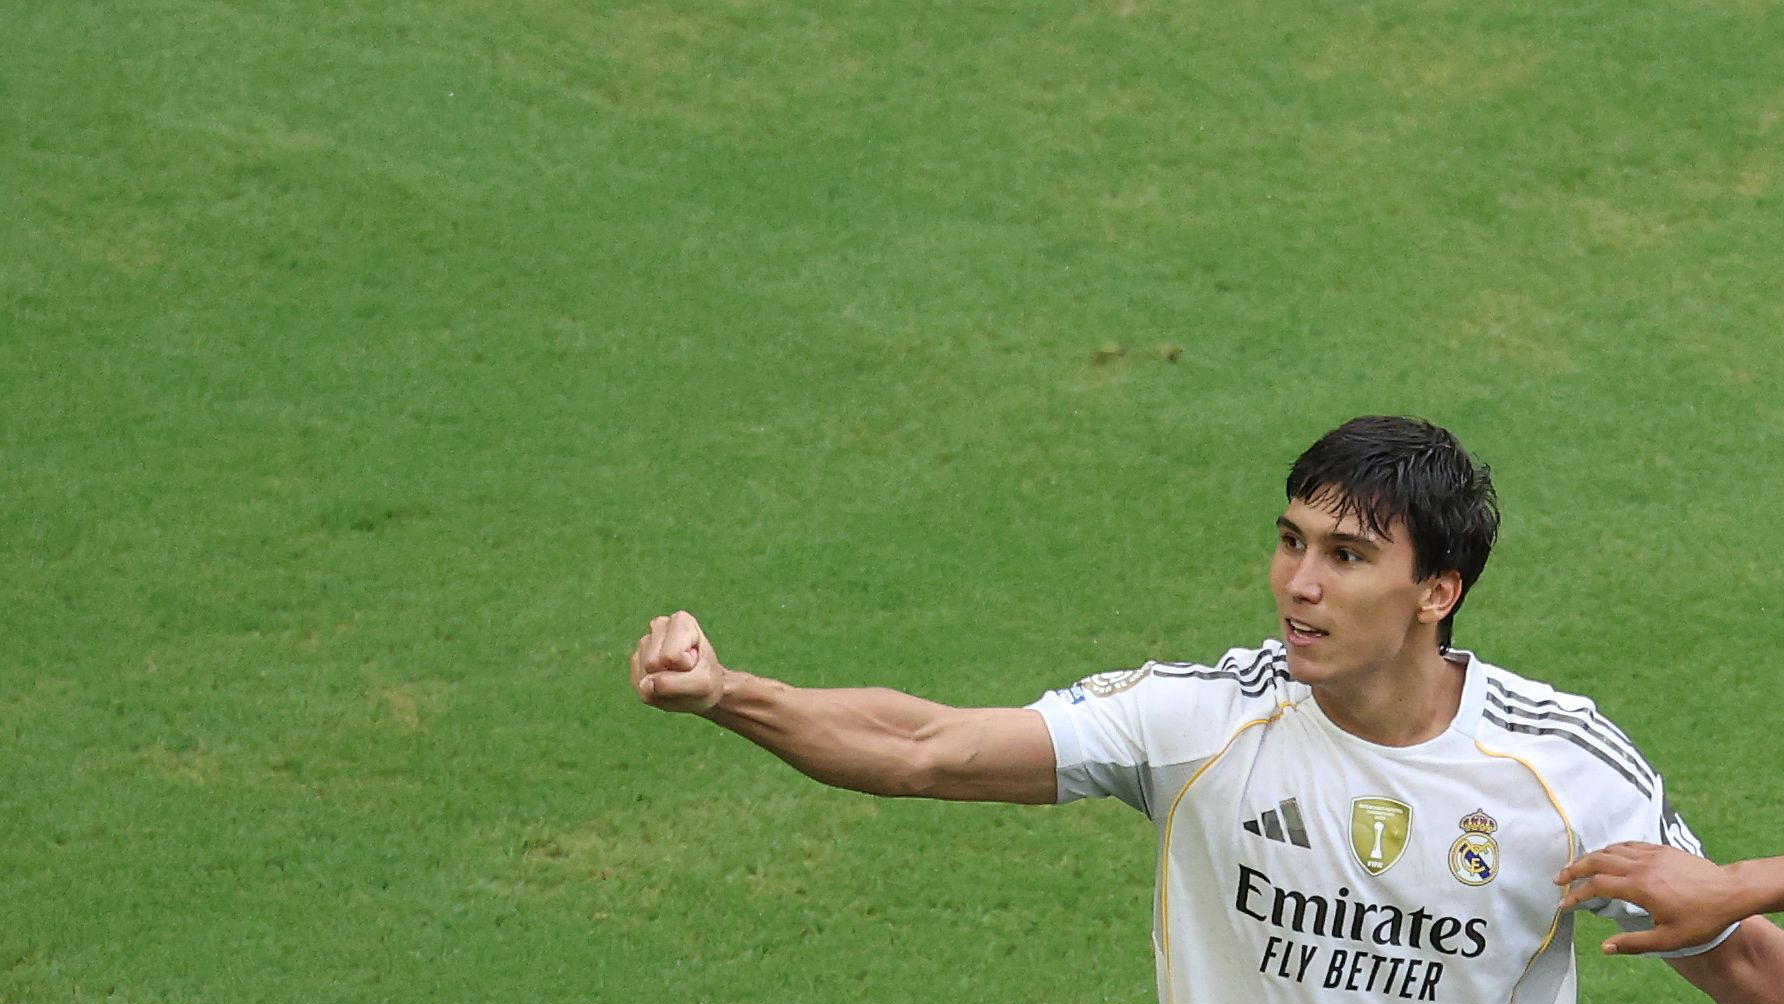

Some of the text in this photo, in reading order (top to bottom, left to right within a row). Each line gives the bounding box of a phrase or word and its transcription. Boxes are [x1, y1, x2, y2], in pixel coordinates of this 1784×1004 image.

[1235, 862, 1488, 959] Emirates
[1259, 935, 1444, 1002] FLY BETTER
